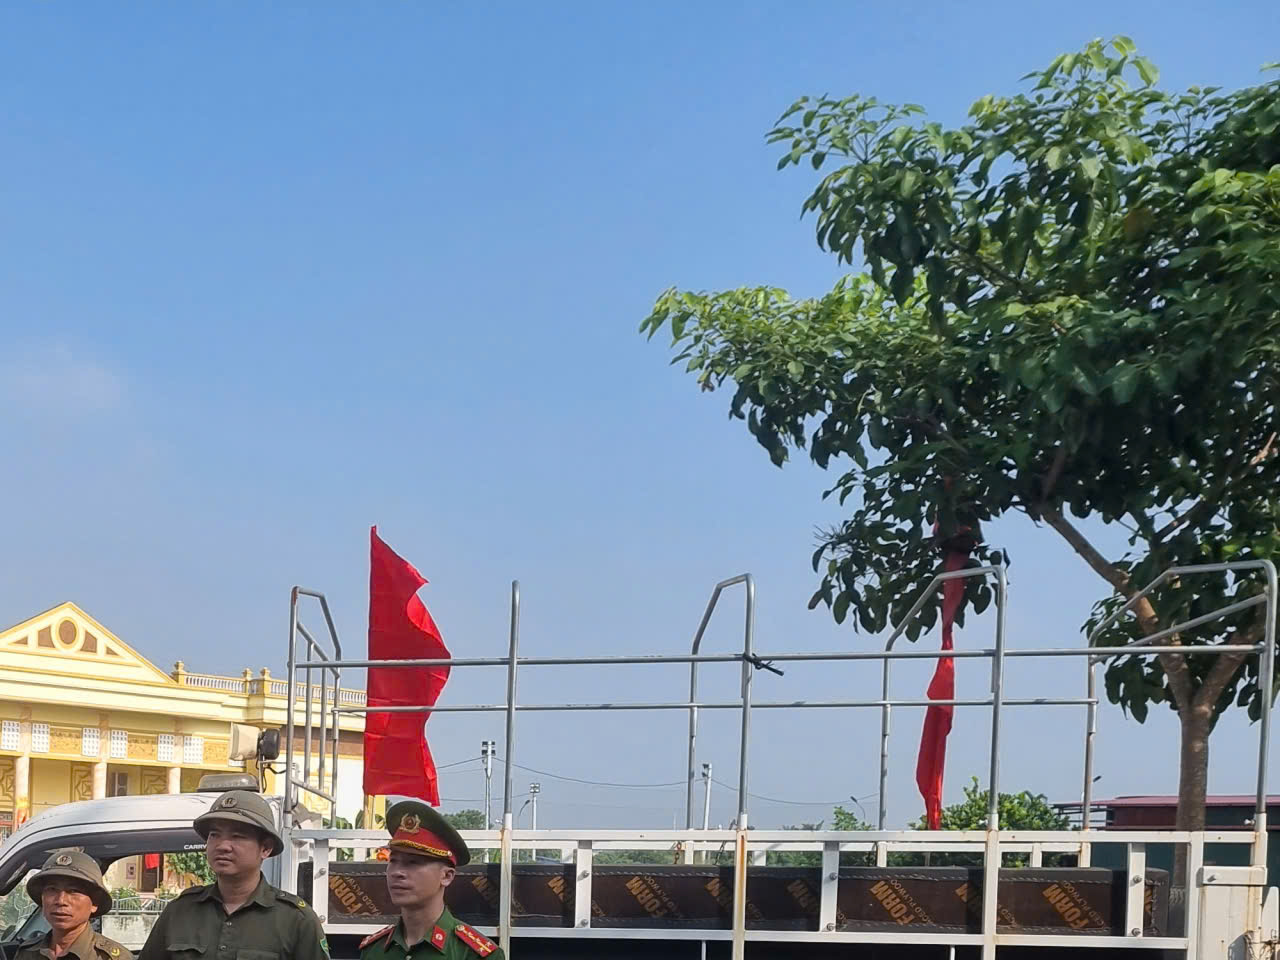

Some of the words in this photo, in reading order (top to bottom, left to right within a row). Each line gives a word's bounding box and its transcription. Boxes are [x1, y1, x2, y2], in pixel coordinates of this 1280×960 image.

[870, 880, 915, 926] FORM
[890, 879, 917, 907] PLYWOO
[1042, 883, 1089, 930] FORM
